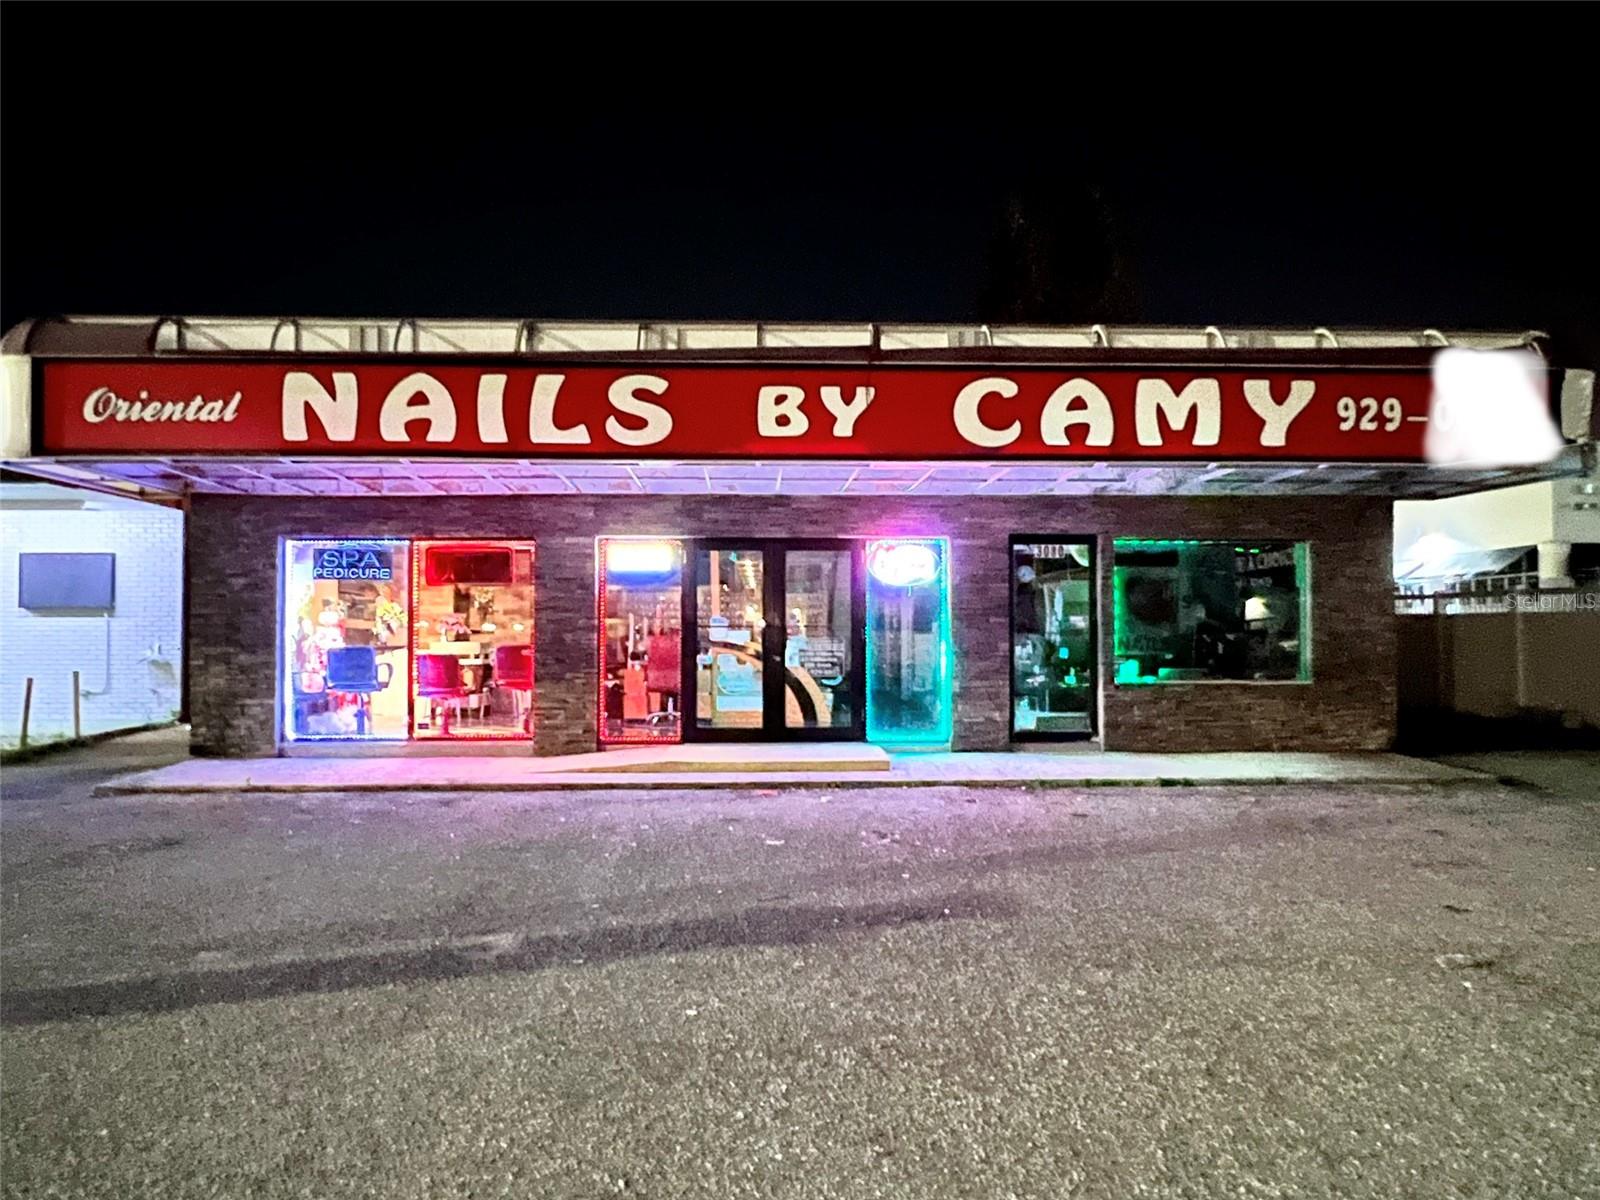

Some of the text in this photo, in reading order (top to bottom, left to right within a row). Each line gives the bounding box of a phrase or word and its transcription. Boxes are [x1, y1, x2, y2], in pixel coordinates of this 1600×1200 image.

[83, 387, 242, 423] Oriental
[282, 371, 673, 447] NAILS
[757, 385, 876, 438] BY
[953, 377, 1316, 448] CAMY
[322, 550, 381, 568] SPA
[314, 568, 390, 579] PEDICURE
